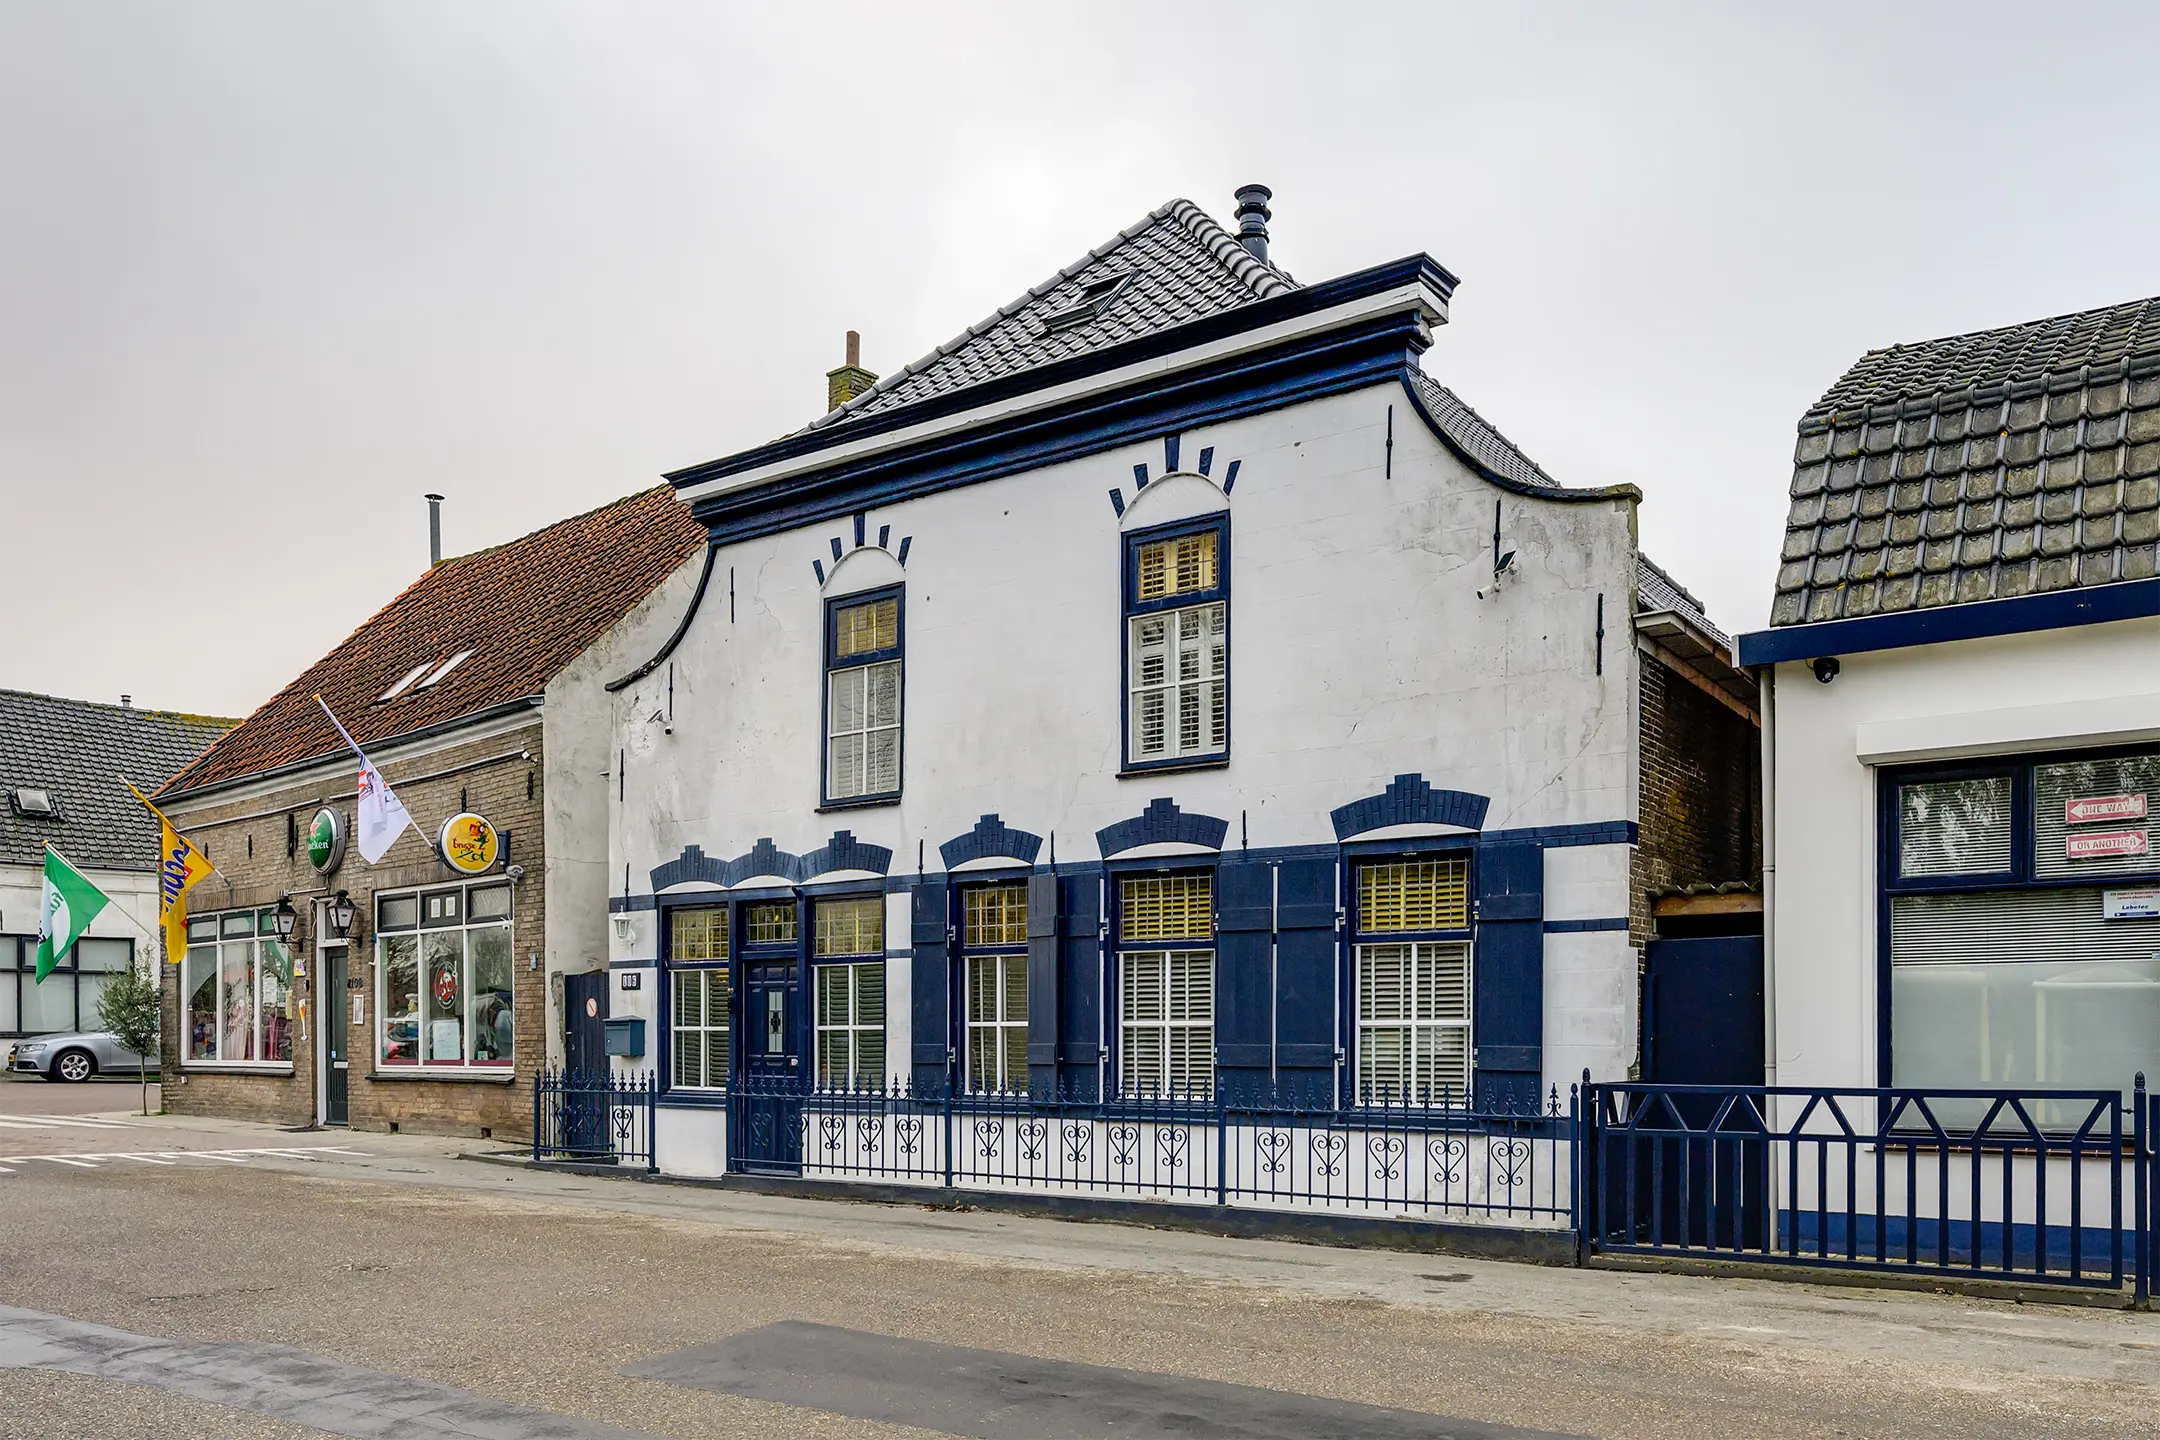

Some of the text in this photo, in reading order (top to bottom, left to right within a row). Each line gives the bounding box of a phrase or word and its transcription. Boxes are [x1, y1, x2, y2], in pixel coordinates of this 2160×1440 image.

[2082, 802, 2130, 814] ONE WAY
[2077, 837, 2136, 850] OR ANOTHER
